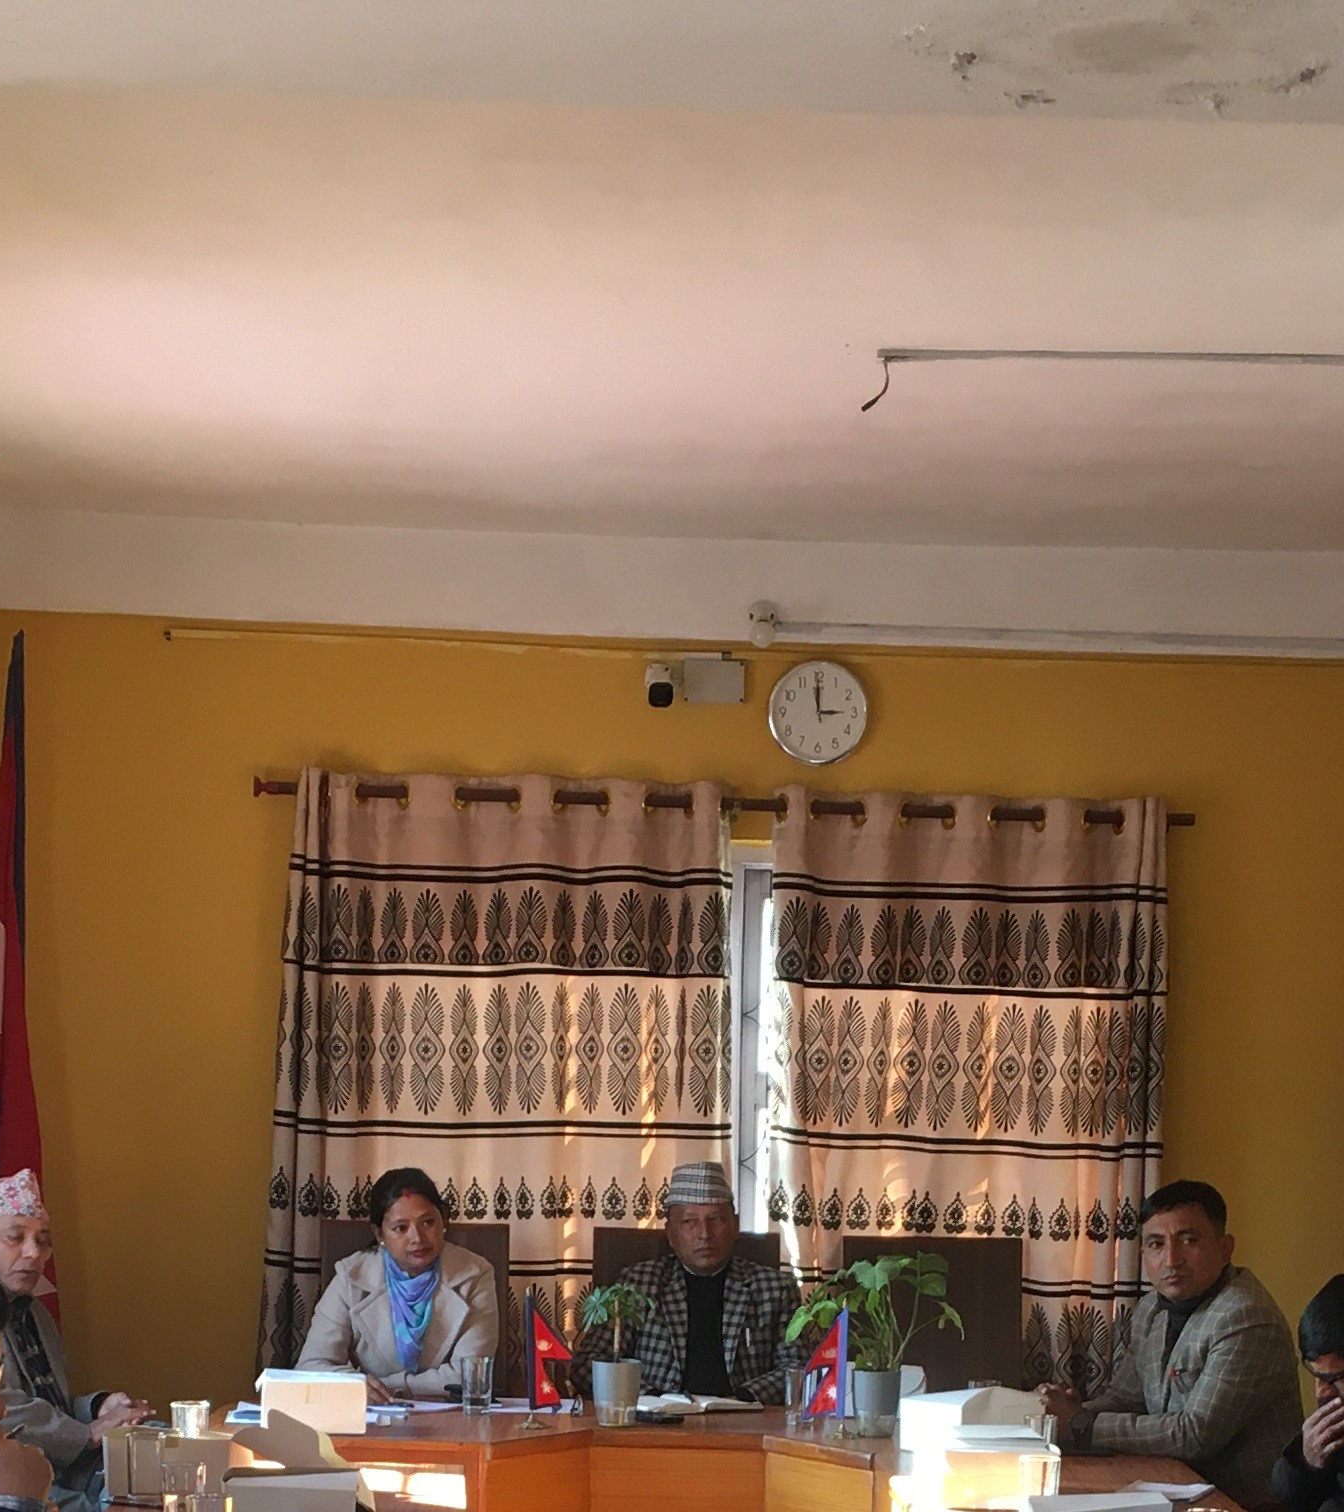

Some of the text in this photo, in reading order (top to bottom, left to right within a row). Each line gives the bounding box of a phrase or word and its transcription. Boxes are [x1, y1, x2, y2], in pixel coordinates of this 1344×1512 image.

[798, 676, 807, 688] 11
[784, 689, 796, 702] 10
[844, 688, 852, 701] 2
[779, 706, 787, 718] 9
[850, 706, 858, 719] 3
[784, 724, 792, 736] 8
[843, 723, 851, 736] 4
[799, 735, 805, 747] 7
[831, 737, 839, 749] 5
[814, 742, 822, 753] 6
